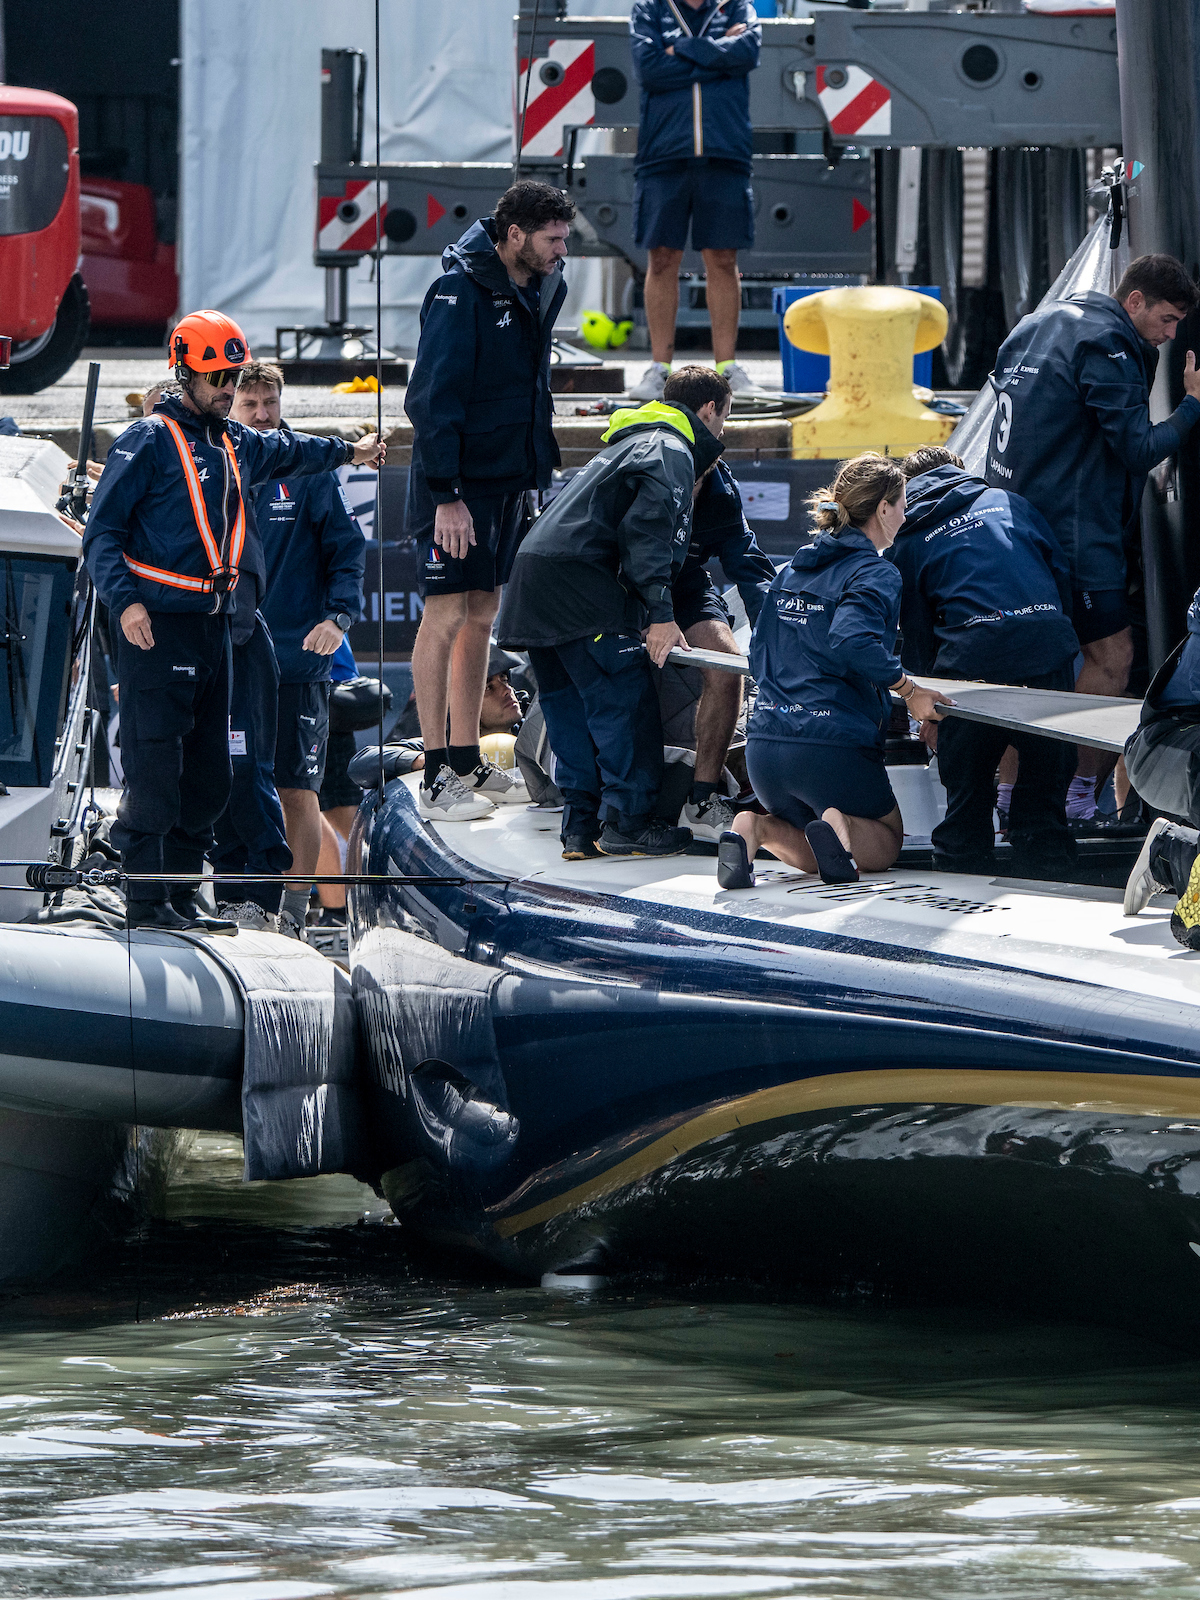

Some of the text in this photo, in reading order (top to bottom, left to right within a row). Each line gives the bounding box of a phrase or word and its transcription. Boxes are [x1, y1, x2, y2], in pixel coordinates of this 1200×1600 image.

[990, 456, 1014, 479] LAPAUW
[925, 524, 948, 543] ORIENT
[974, 506, 1005, 516] EXPRESS
[1014, 605, 1034, 616] PURE
[1034, 603, 1058, 612] OCEAN
